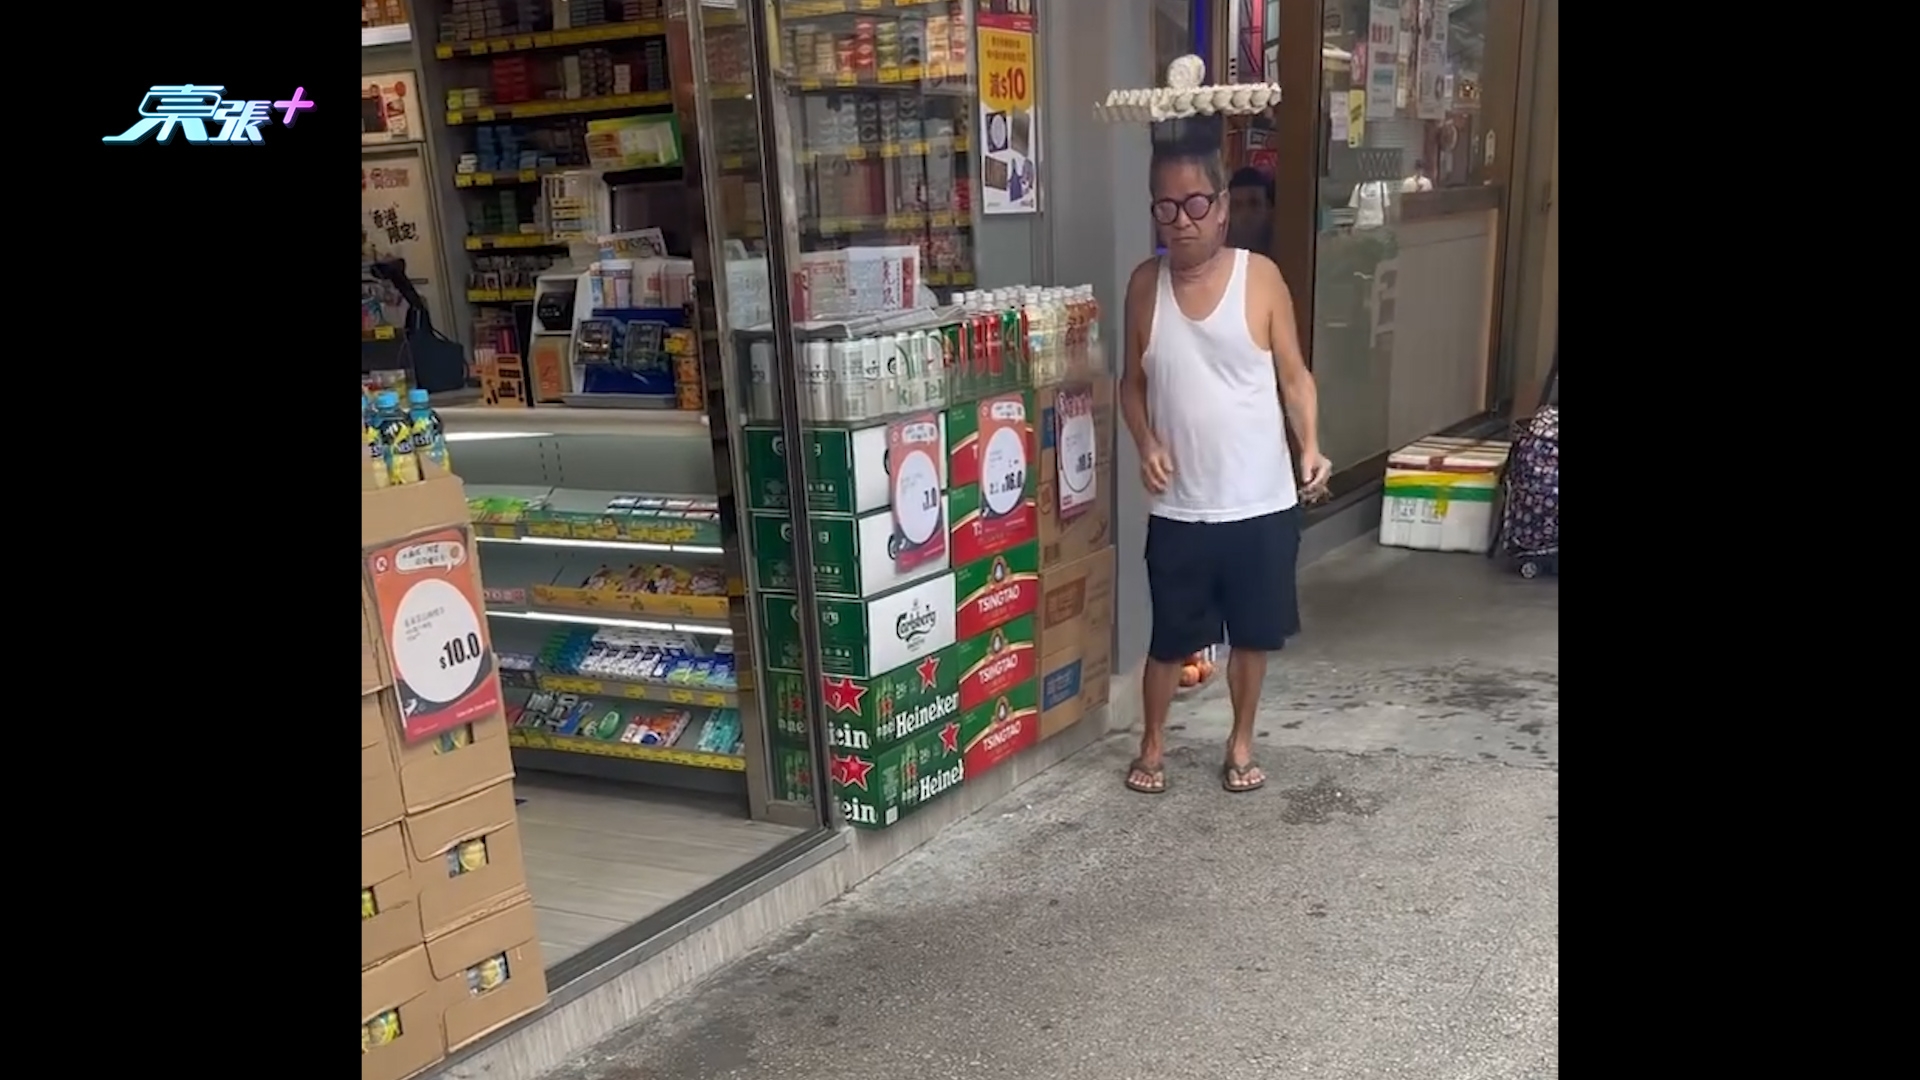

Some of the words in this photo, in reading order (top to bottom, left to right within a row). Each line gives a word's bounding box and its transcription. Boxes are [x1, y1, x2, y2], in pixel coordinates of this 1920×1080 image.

[978, 584, 1020, 613] TSINGTAO
[896, 604, 936, 641] Carlsberg
[439, 632, 480, 669] $10.0
[978, 653, 1019, 684] TSINGTAO
[983, 720, 1022, 751] TSINGTAO
